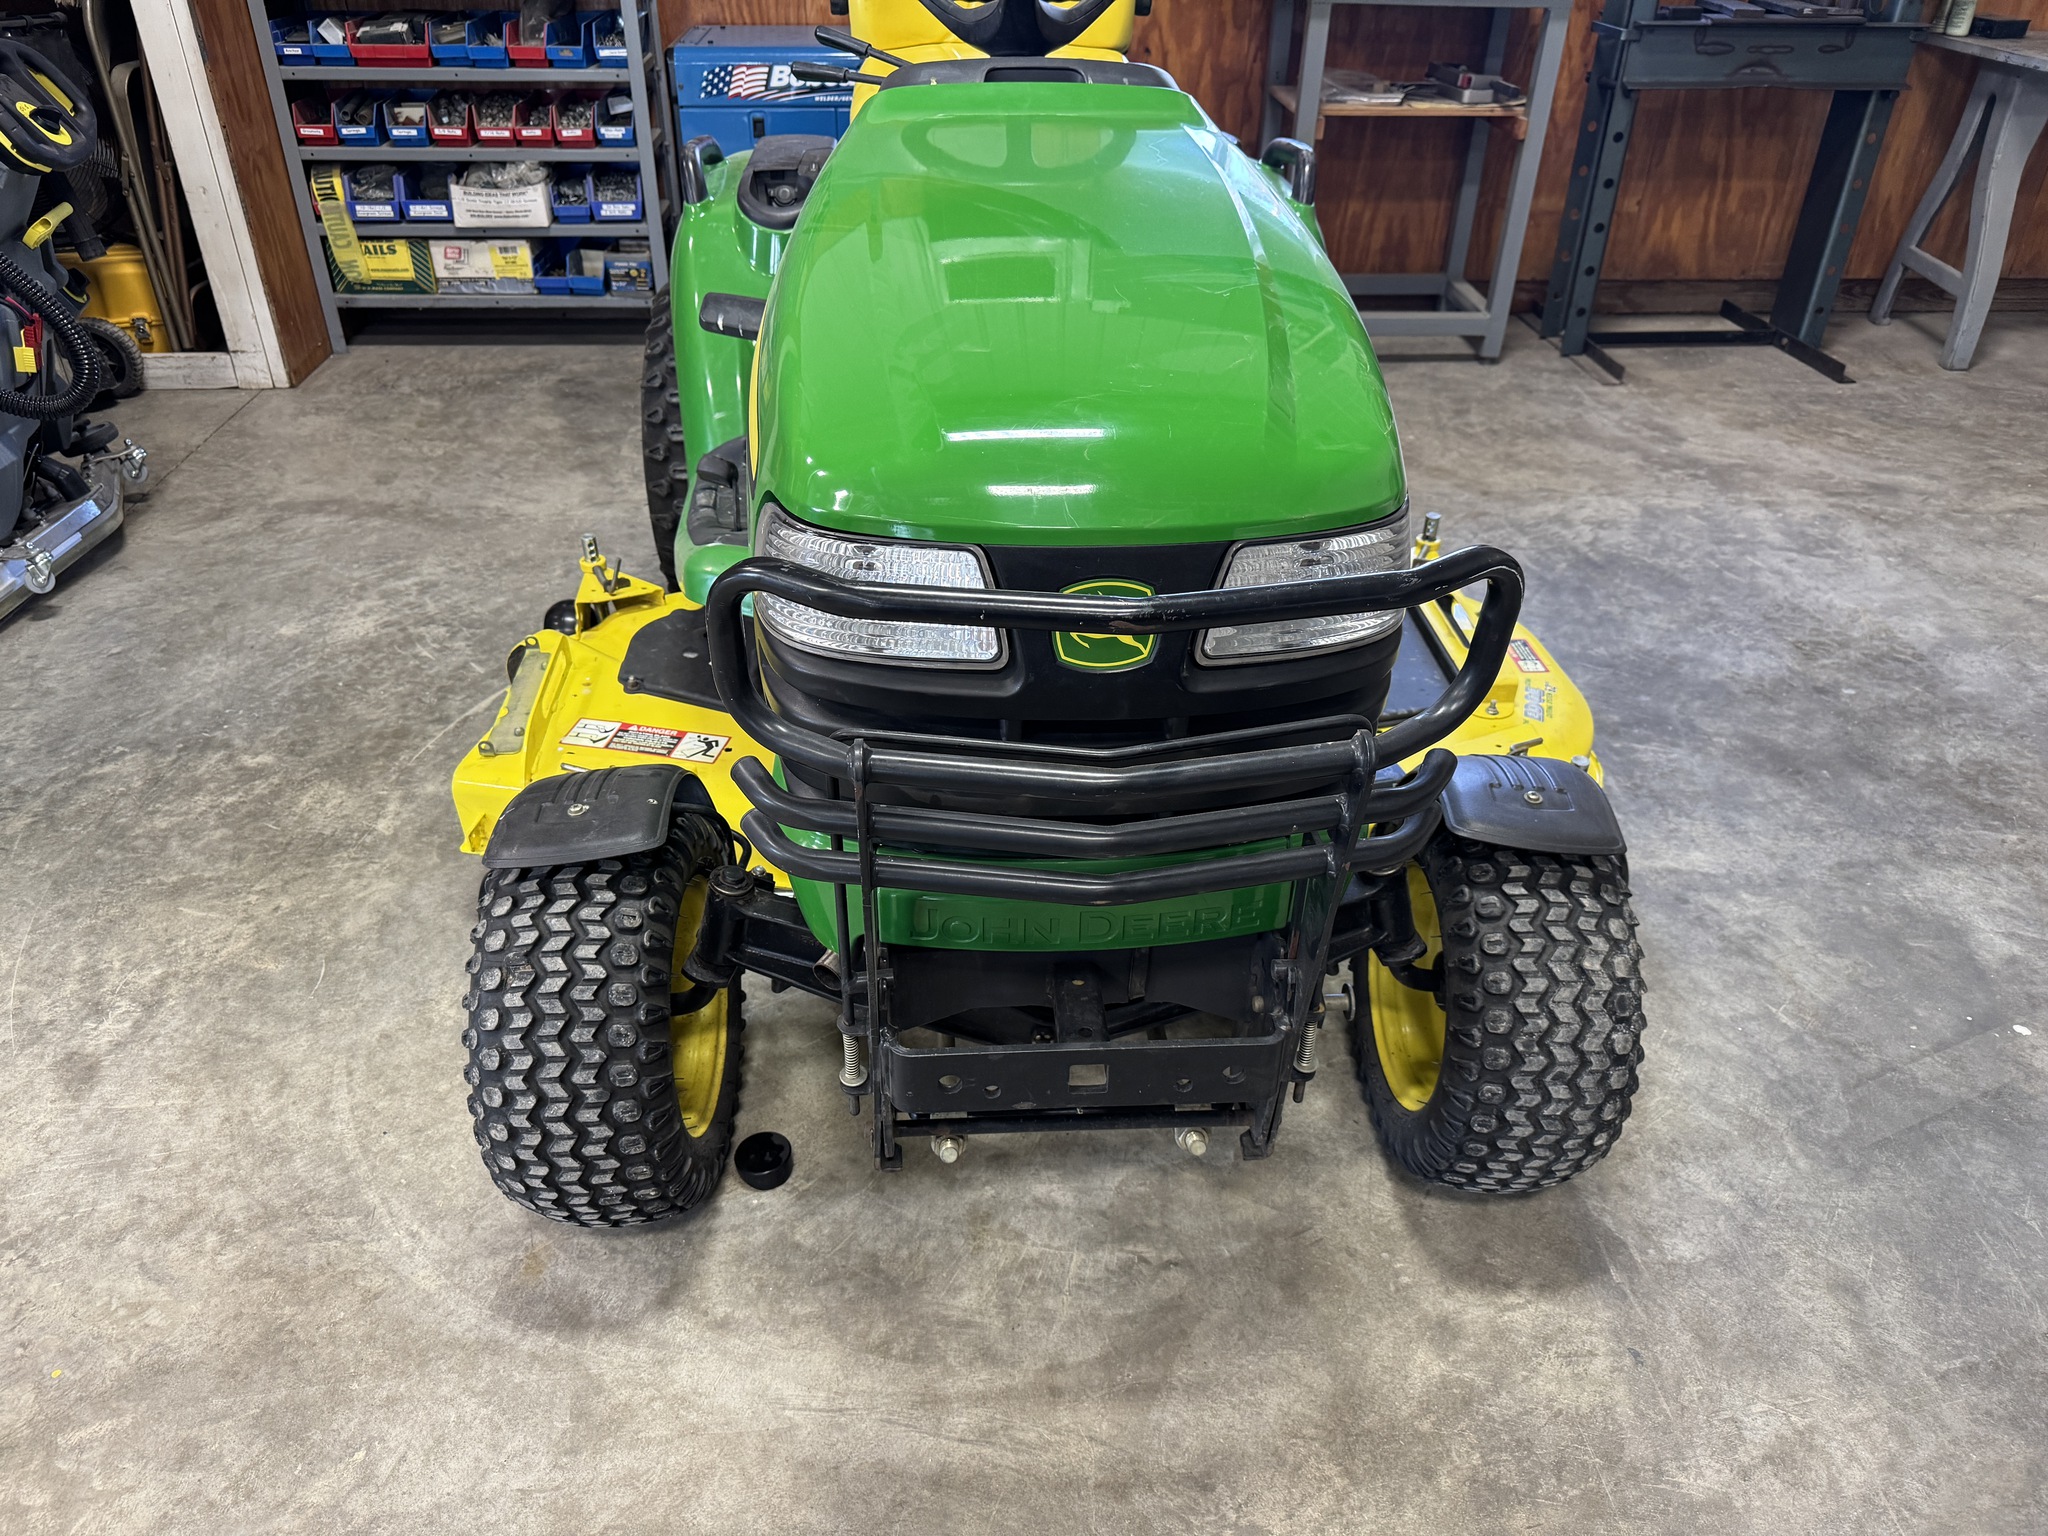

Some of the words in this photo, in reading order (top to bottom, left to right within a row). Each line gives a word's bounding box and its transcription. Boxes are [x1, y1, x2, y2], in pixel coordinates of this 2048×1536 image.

[638, 726, 679, 736] DANGER
[910, 908, 1061, 945] JOHN
[1078, 899, 1263, 943] DEERE
